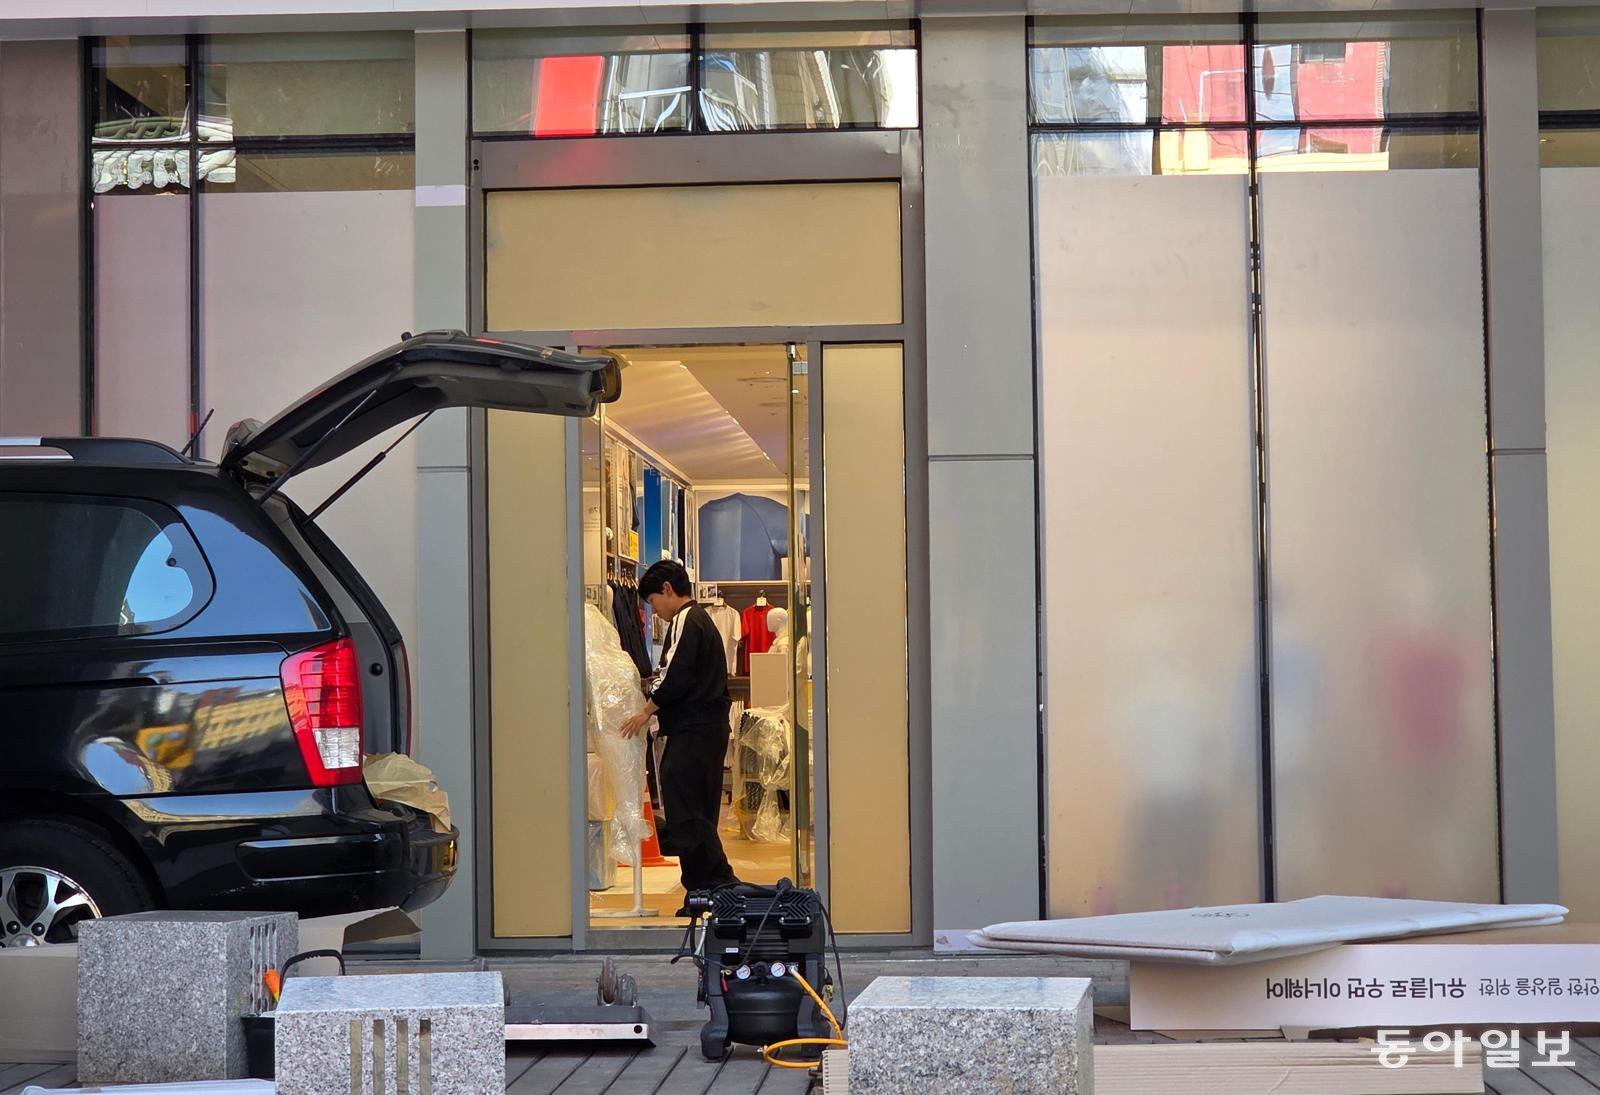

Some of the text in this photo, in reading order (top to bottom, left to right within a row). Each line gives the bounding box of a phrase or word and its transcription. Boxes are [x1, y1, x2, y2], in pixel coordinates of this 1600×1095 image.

[1266, 978, 1342, 1000] 이너웨어
[1348, 978, 1386, 999] 우먼
[1390, 978, 1467, 999] 유니클로
[1479, 978, 1512, 996] 위한
[1515, 978, 1564, 996] 일상을
